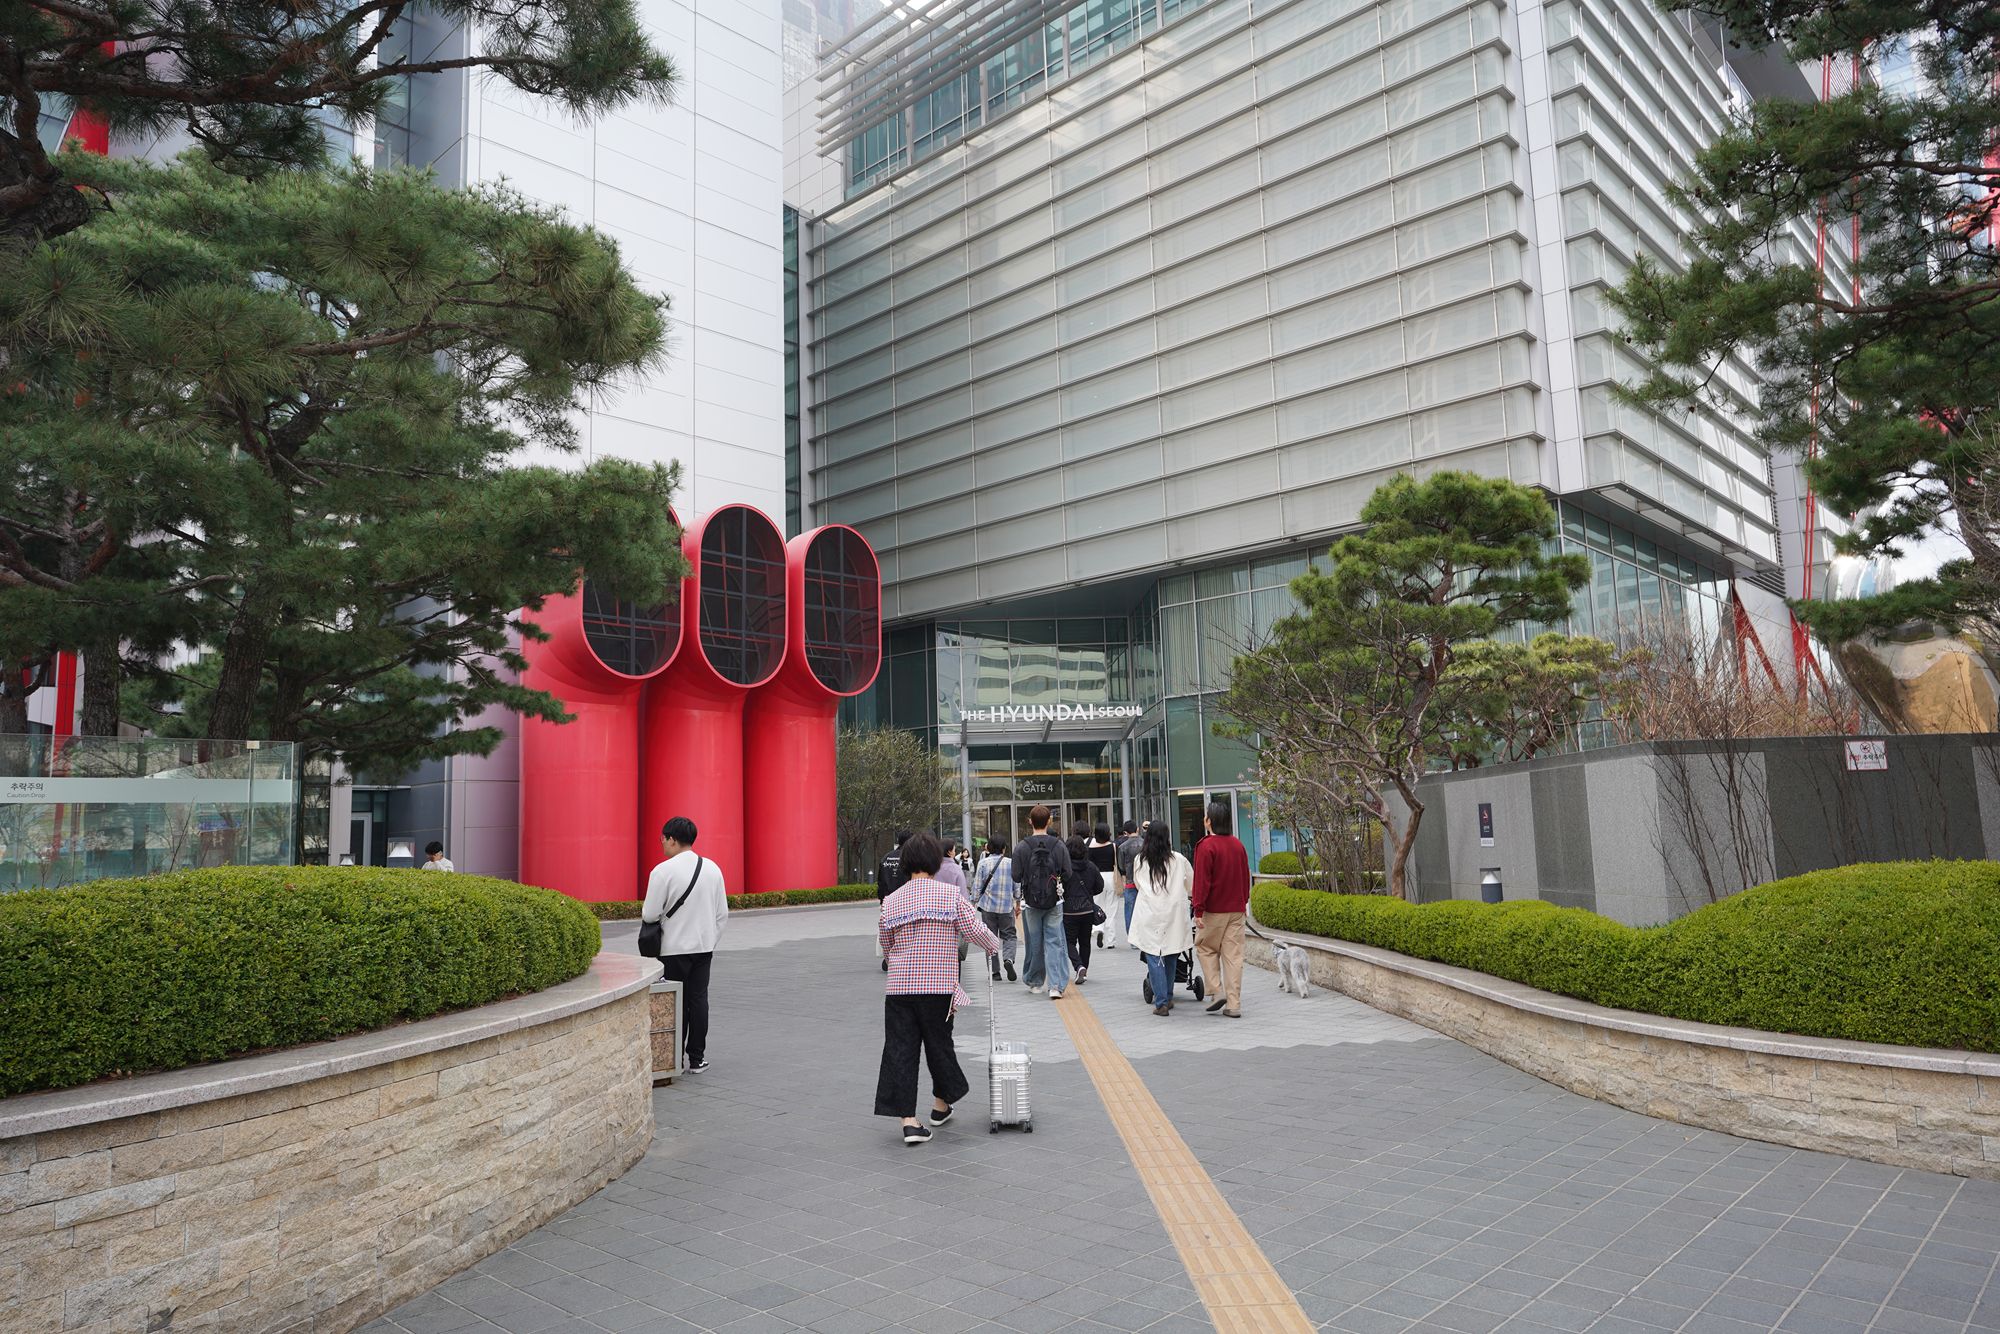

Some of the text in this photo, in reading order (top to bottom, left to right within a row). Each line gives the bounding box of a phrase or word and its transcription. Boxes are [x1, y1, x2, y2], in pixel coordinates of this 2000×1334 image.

[959, 704, 1143, 723] THE HYUNDAI SEOUL
[10, 782, 44, 791] 추락주의
[1022, 784, 1054, 793] GATE 4
